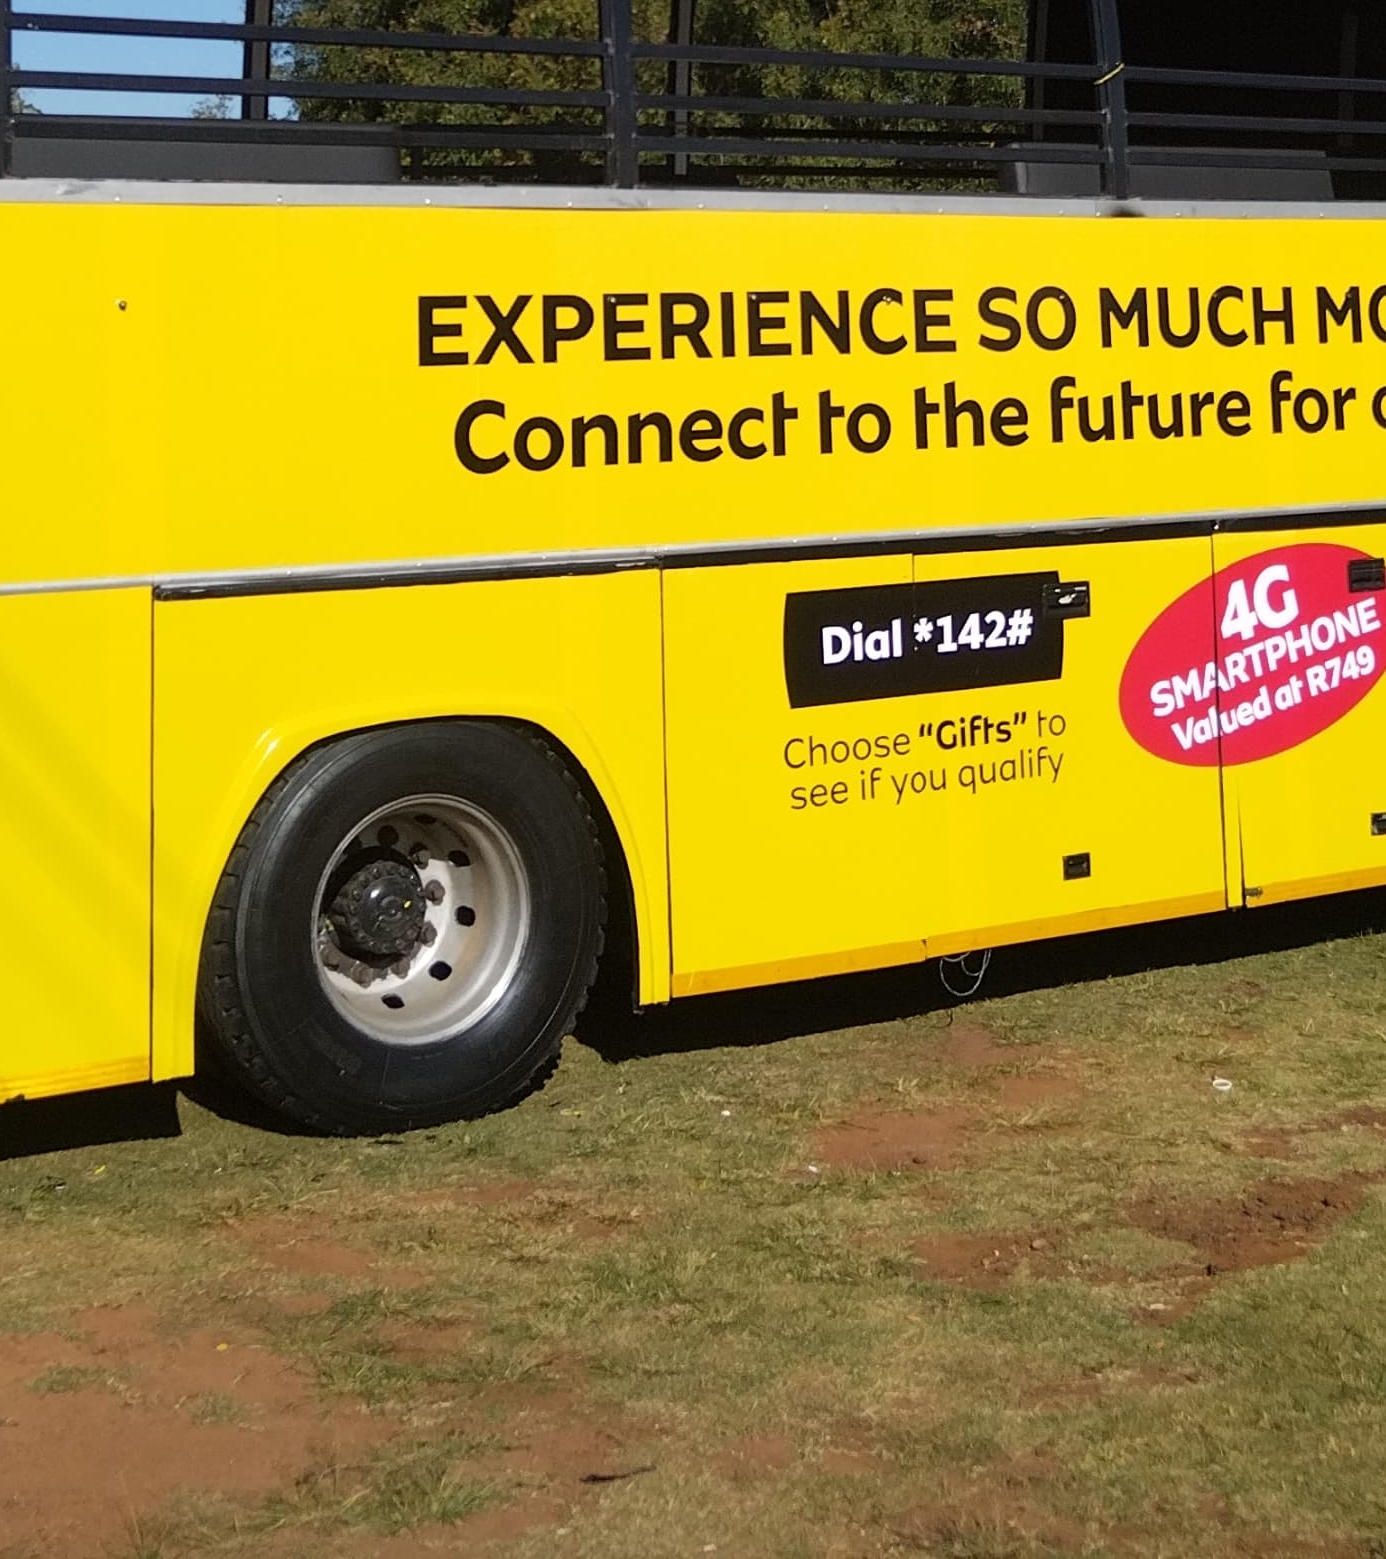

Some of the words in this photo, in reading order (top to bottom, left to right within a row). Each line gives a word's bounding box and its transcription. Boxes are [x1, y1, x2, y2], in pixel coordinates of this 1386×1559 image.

[418, 289, 957, 367] EXPERIENCE
[978, 286, 1077, 352] SO
[1099, 285, 1295, 351] MUCH
[454, 391, 799, 475] Connect
[817, 389, 892, 455] to
[913, 381, 1029, 450] the
[1049, 375, 1252, 443] future
[1270, 370, 1356, 434] for
[821, 617, 903, 665] Dial
[1220, 564, 1300, 641] 4G
[1149, 597, 1382, 717] SMARTPHONE
[1170, 685, 1273, 751] Valued
[1274, 675, 1303, 712] at
[1306, 645, 1376, 697] R749
[783, 733, 911, 769] Choose
[918, 711, 1027, 750] "Gifts"
[1037, 710, 1066, 738] to
[790, 782, 849, 810] see
[860, 767, 883, 800] if
[891, 768, 947, 805] you
[957, 746, 1065, 794] qualify
